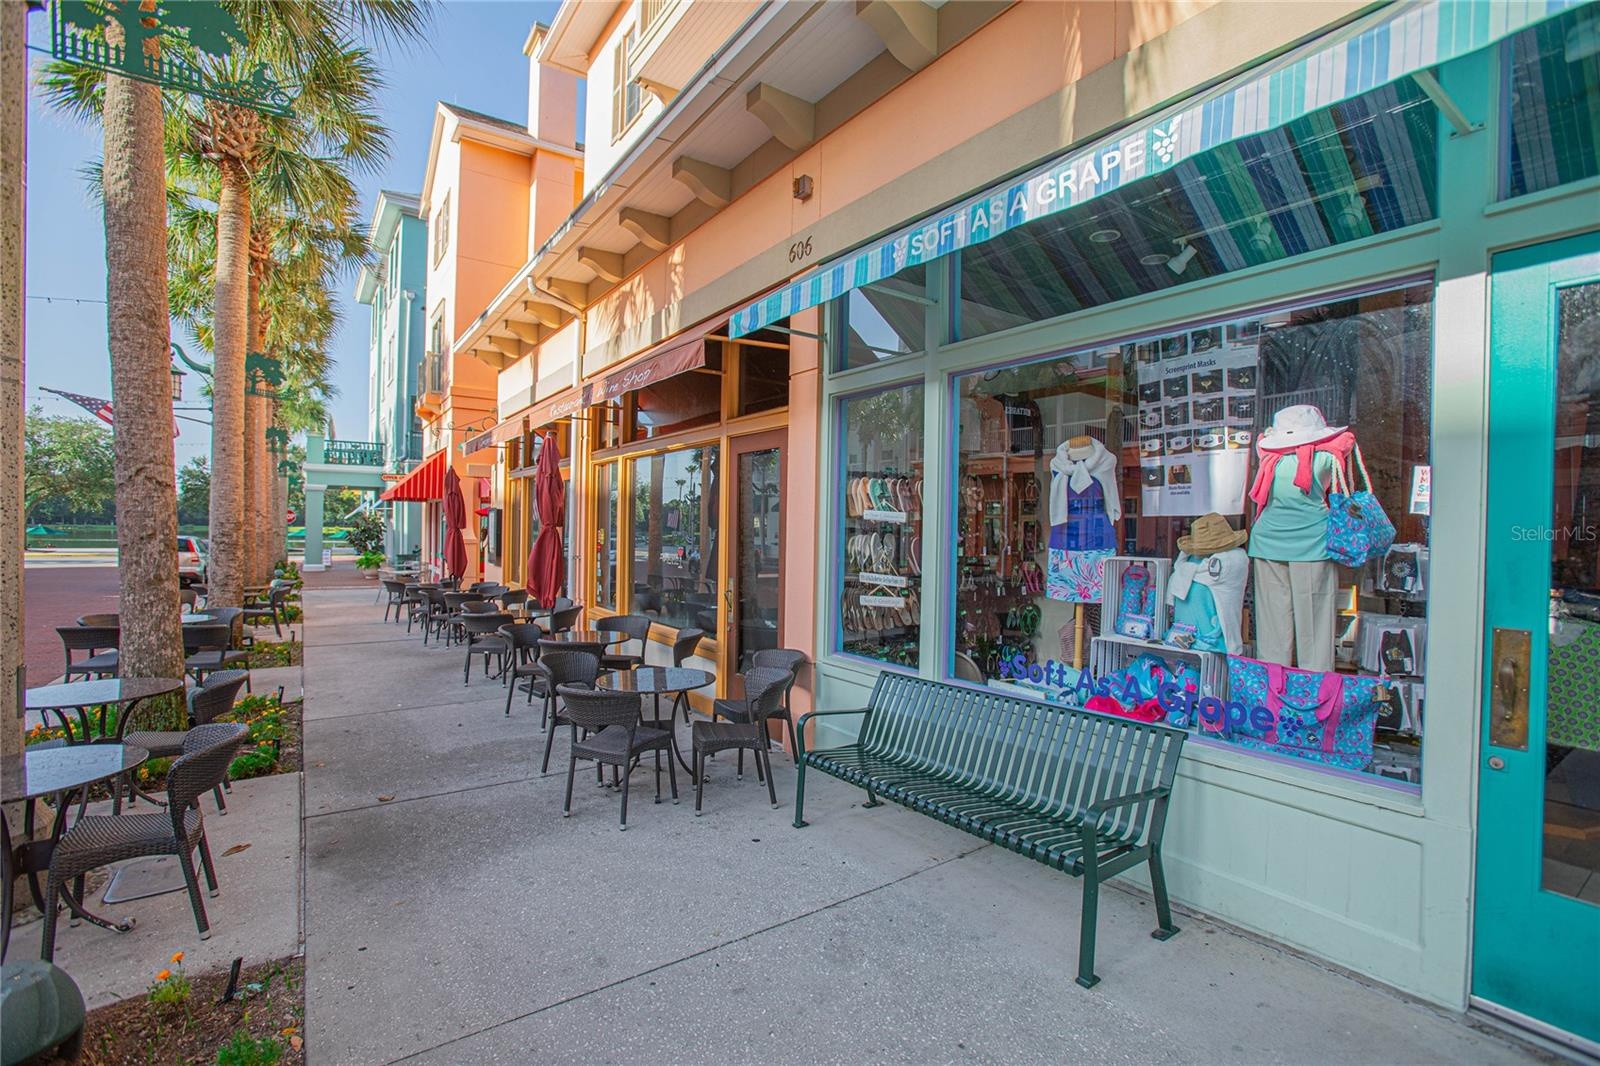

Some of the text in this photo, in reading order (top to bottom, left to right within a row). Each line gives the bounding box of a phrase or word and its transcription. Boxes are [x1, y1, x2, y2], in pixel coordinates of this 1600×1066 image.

[911, 138, 1146, 256] SOFT AS A GRAPE
[788, 235, 812, 263] 606
[1164, 358, 1217, 375] Screenprint Masks
[596, 380, 619, 398] Wine
[622, 368, 651, 388] Shop
[1010, 653, 1275, 732] Soft As A Grape
